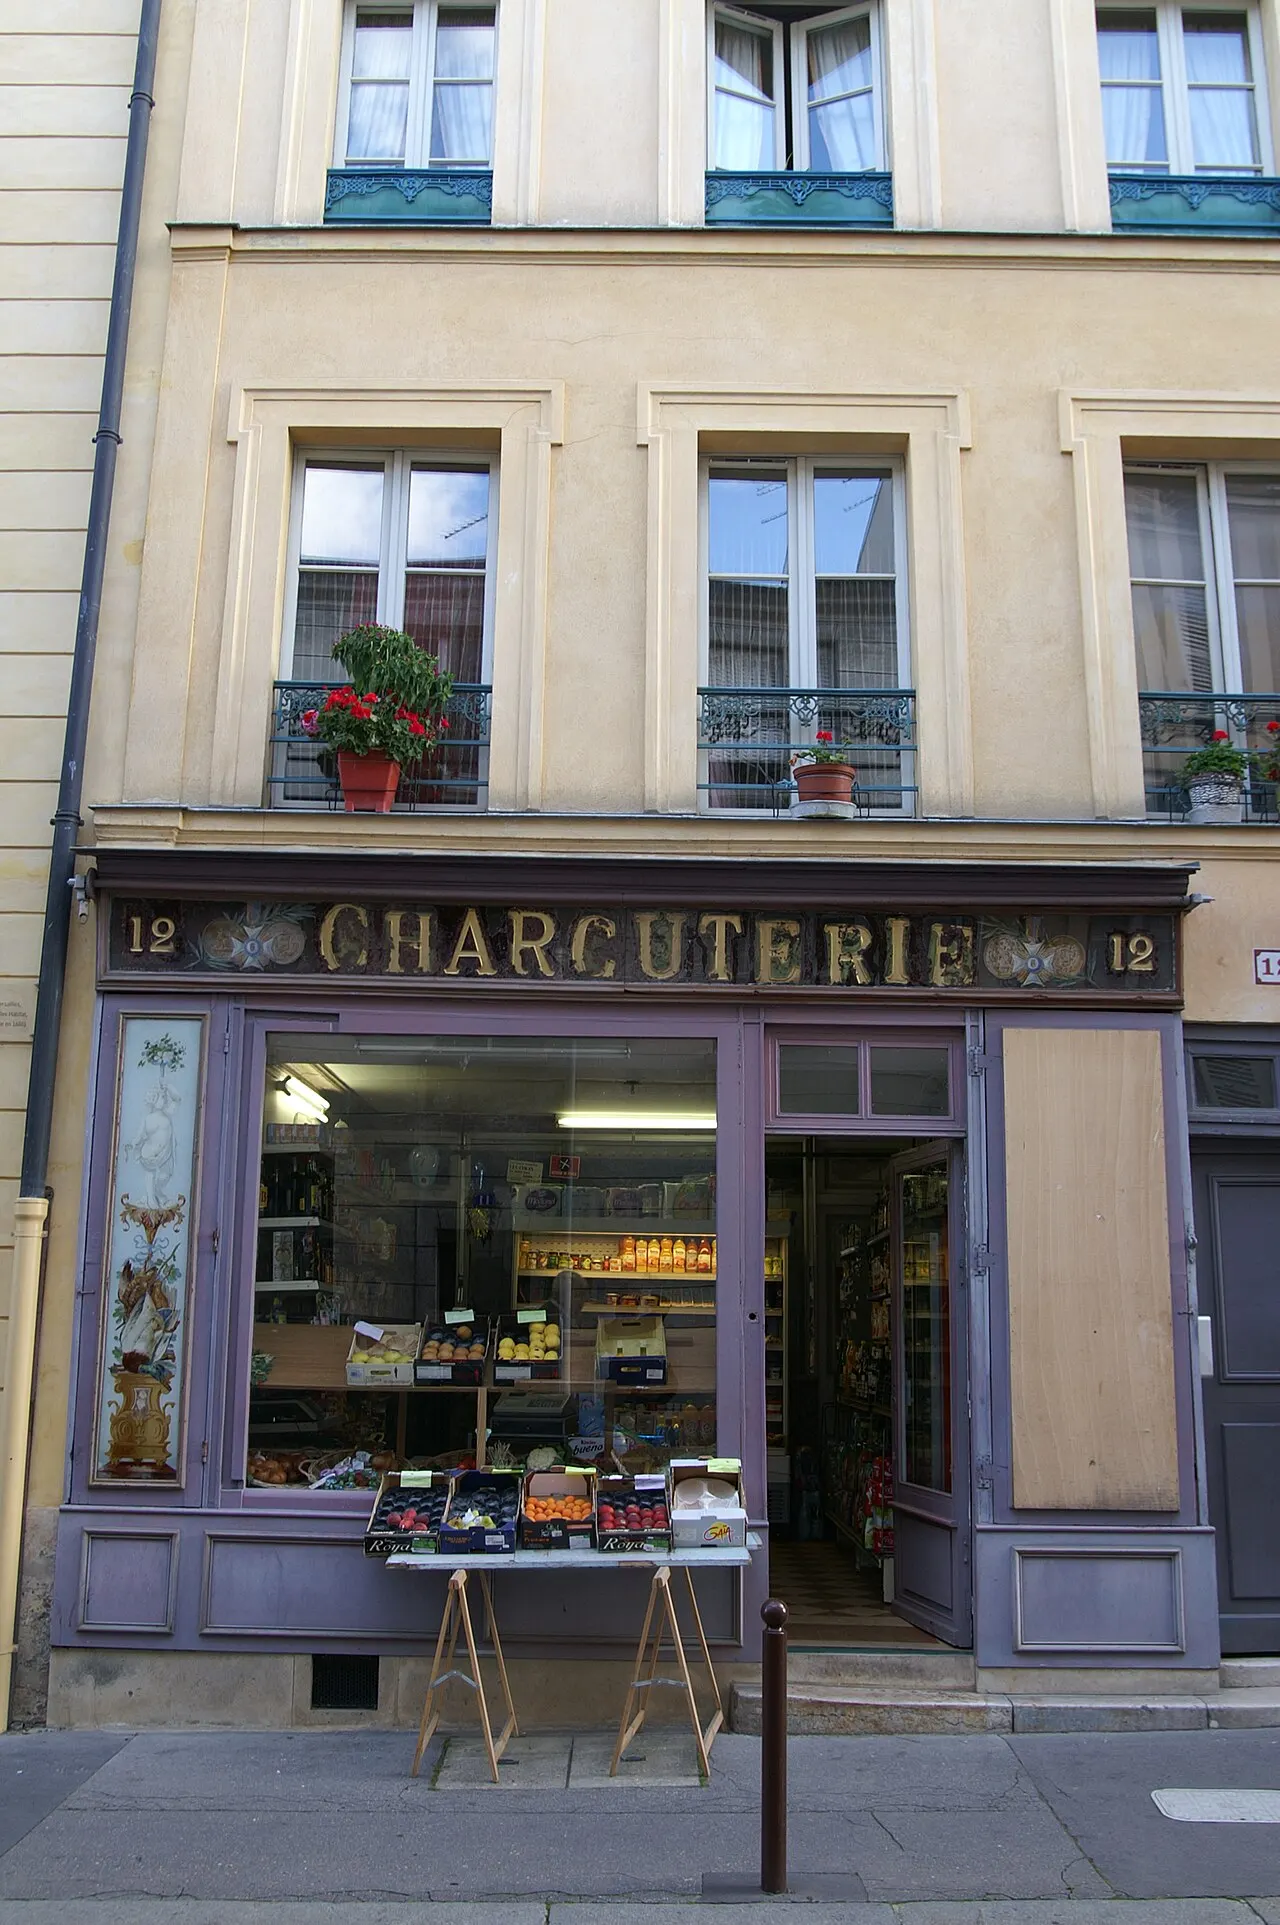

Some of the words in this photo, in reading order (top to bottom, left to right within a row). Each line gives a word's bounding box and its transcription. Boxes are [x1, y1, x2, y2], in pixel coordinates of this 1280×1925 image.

[129, 916, 176, 953] 12
[319, 903, 973, 986] CHARCUTERIE
[1111, 933, 1153, 971] 12
[1262, 958, 1280, 976] 1
[573, 1444, 603, 1456] bueno
[369, 1539, 411, 1553] Roya
[603, 1537, 645, 1551] Roya
